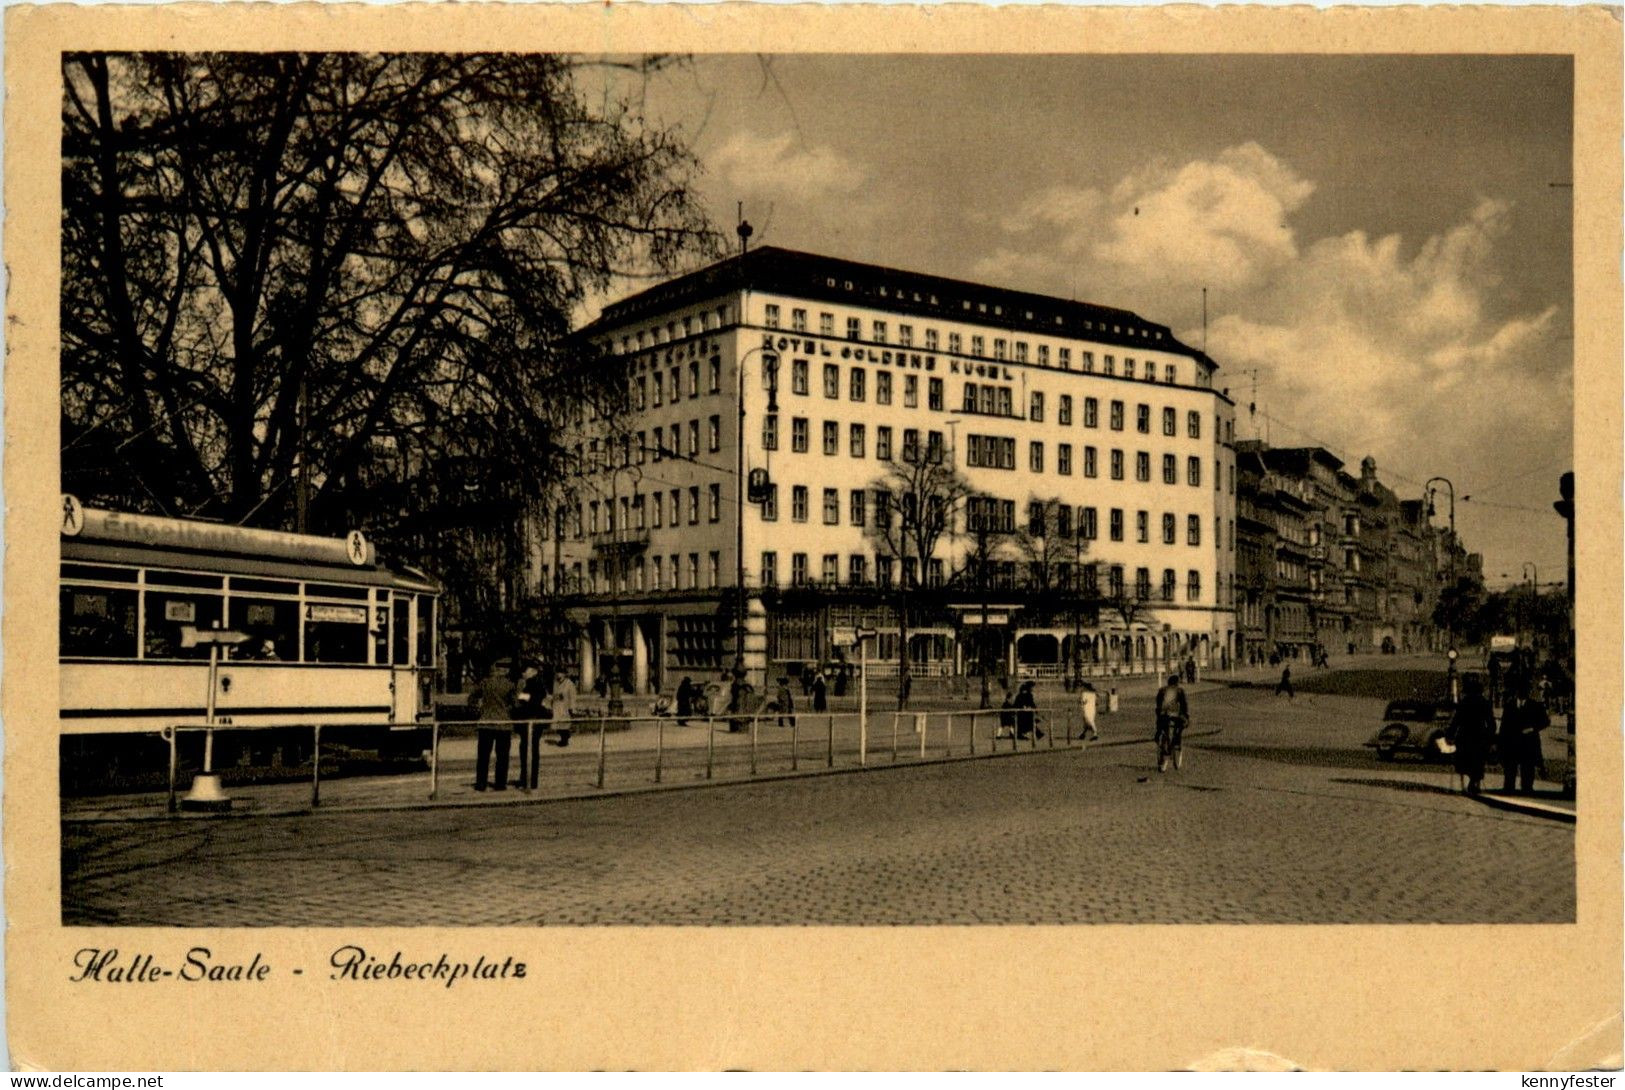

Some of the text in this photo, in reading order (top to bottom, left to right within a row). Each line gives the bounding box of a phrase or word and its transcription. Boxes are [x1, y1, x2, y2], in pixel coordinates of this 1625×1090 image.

[762, 333, 1013, 380] HOTEL GOLDENE KUGEL
